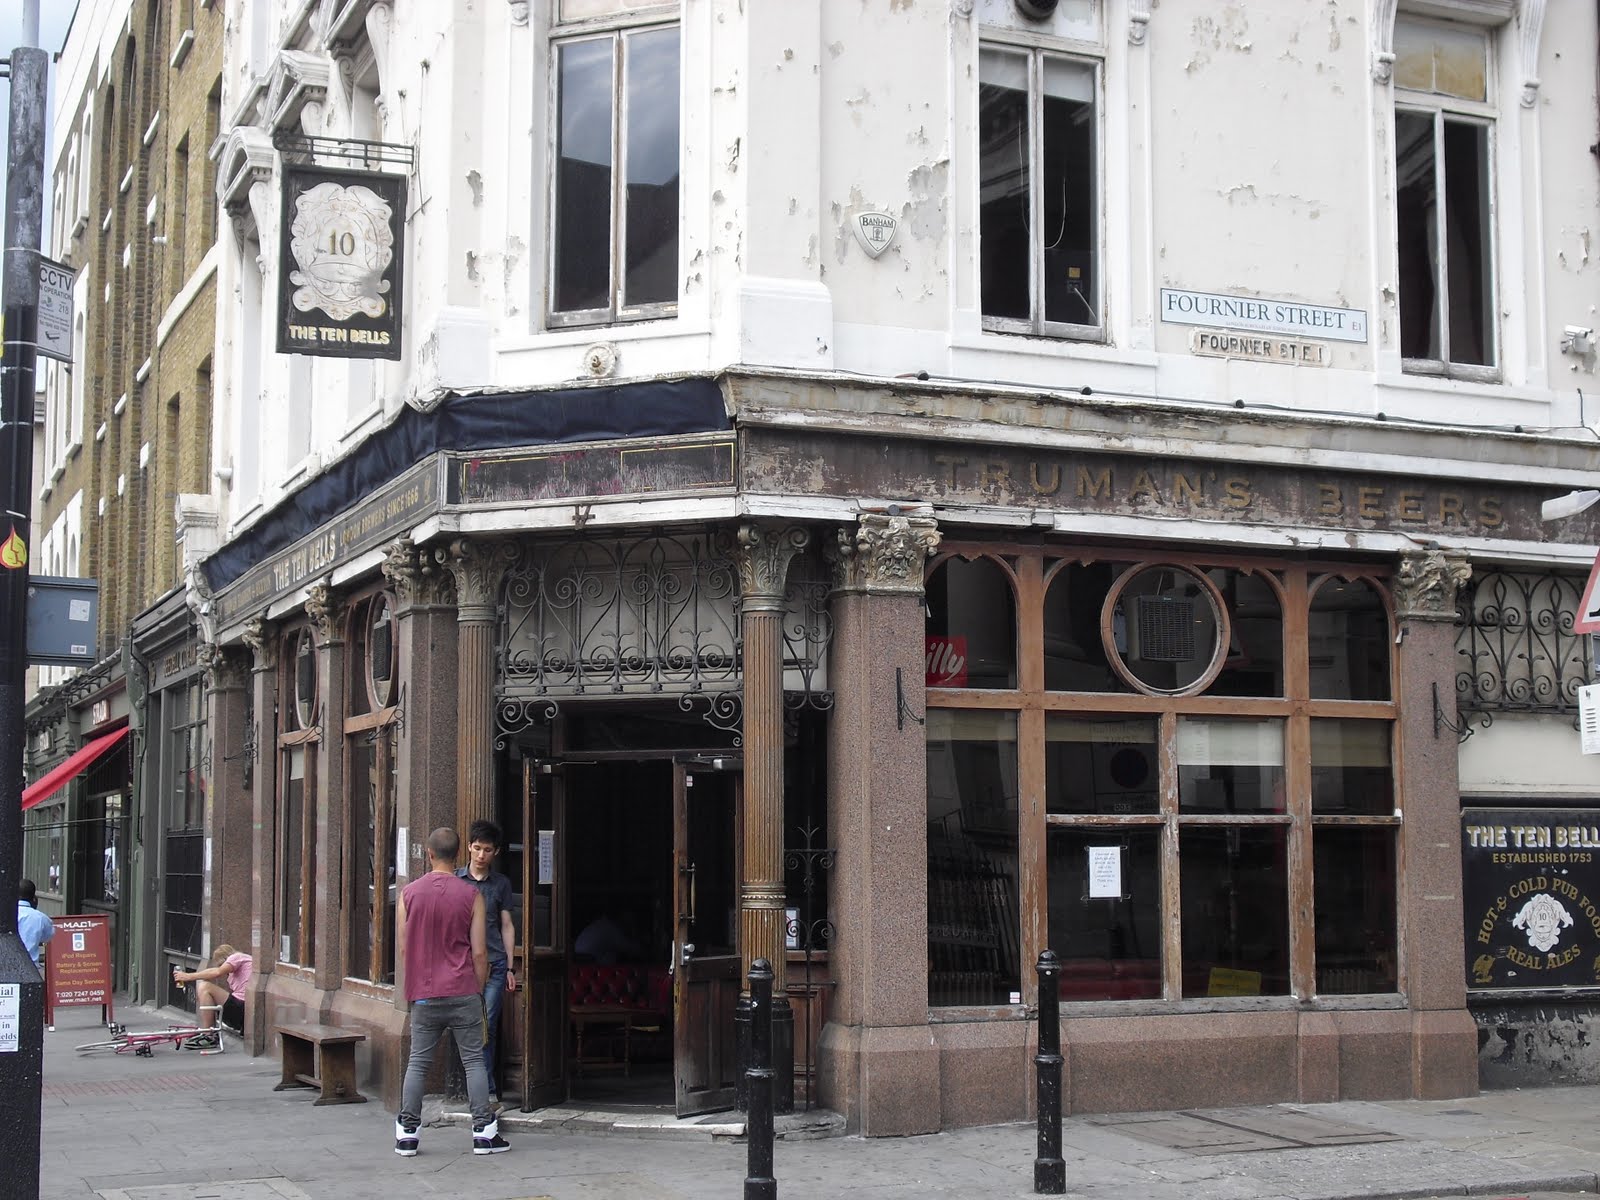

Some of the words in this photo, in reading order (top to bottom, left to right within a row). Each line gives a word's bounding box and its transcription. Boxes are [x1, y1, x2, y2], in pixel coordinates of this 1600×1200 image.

[862, 217, 894, 228] BANHAM
[329, 229, 355, 256] 10
[40, 267, 72, 291] CCTV
[44, 286, 72, 301] OPERATION
[1167, 293, 1270, 321] FOURNIER
[1275, 305, 1346, 329] STREET
[289, 325, 317, 340] THE
[319, 327, 347, 341] TEN
[350, 328, 390, 345] BELLS
[1352, 323, 1361, 331] E1
[1200, 334, 1271, 357] FOURNIER
[935, 455, 1252, 508] TRUMAN'S
[1317, 483, 1504, 527] BEERS
[387, 499, 404, 519] SINCE
[273, 559, 290, 592] THE
[291, 551, 307, 585] TEN
[309, 530, 336, 572] BELLS
[926, 642, 965, 681] illy
[1466, 826, 1507, 847] THE
[1510, 826, 1550, 847] TEN
[1555, 826, 1600, 847] BELL
[1492, 853, 1566, 863] ESTABLISHED
[1569, 853, 1592, 863] 1753
[1478, 907, 1499, 945] HOT
[1497, 896, 1507, 911] &
[1509, 876, 1548, 899] COLD
[1552, 877, 1579, 900] PUB
[1579, 895, 1600, 939] FOOD
[1539, 913, 1547, 921] 10
[63, 920, 91, 928] MAC1
[1506, 945, 1542, 970] REAL
[1546, 944, 1581, 969] ALES
